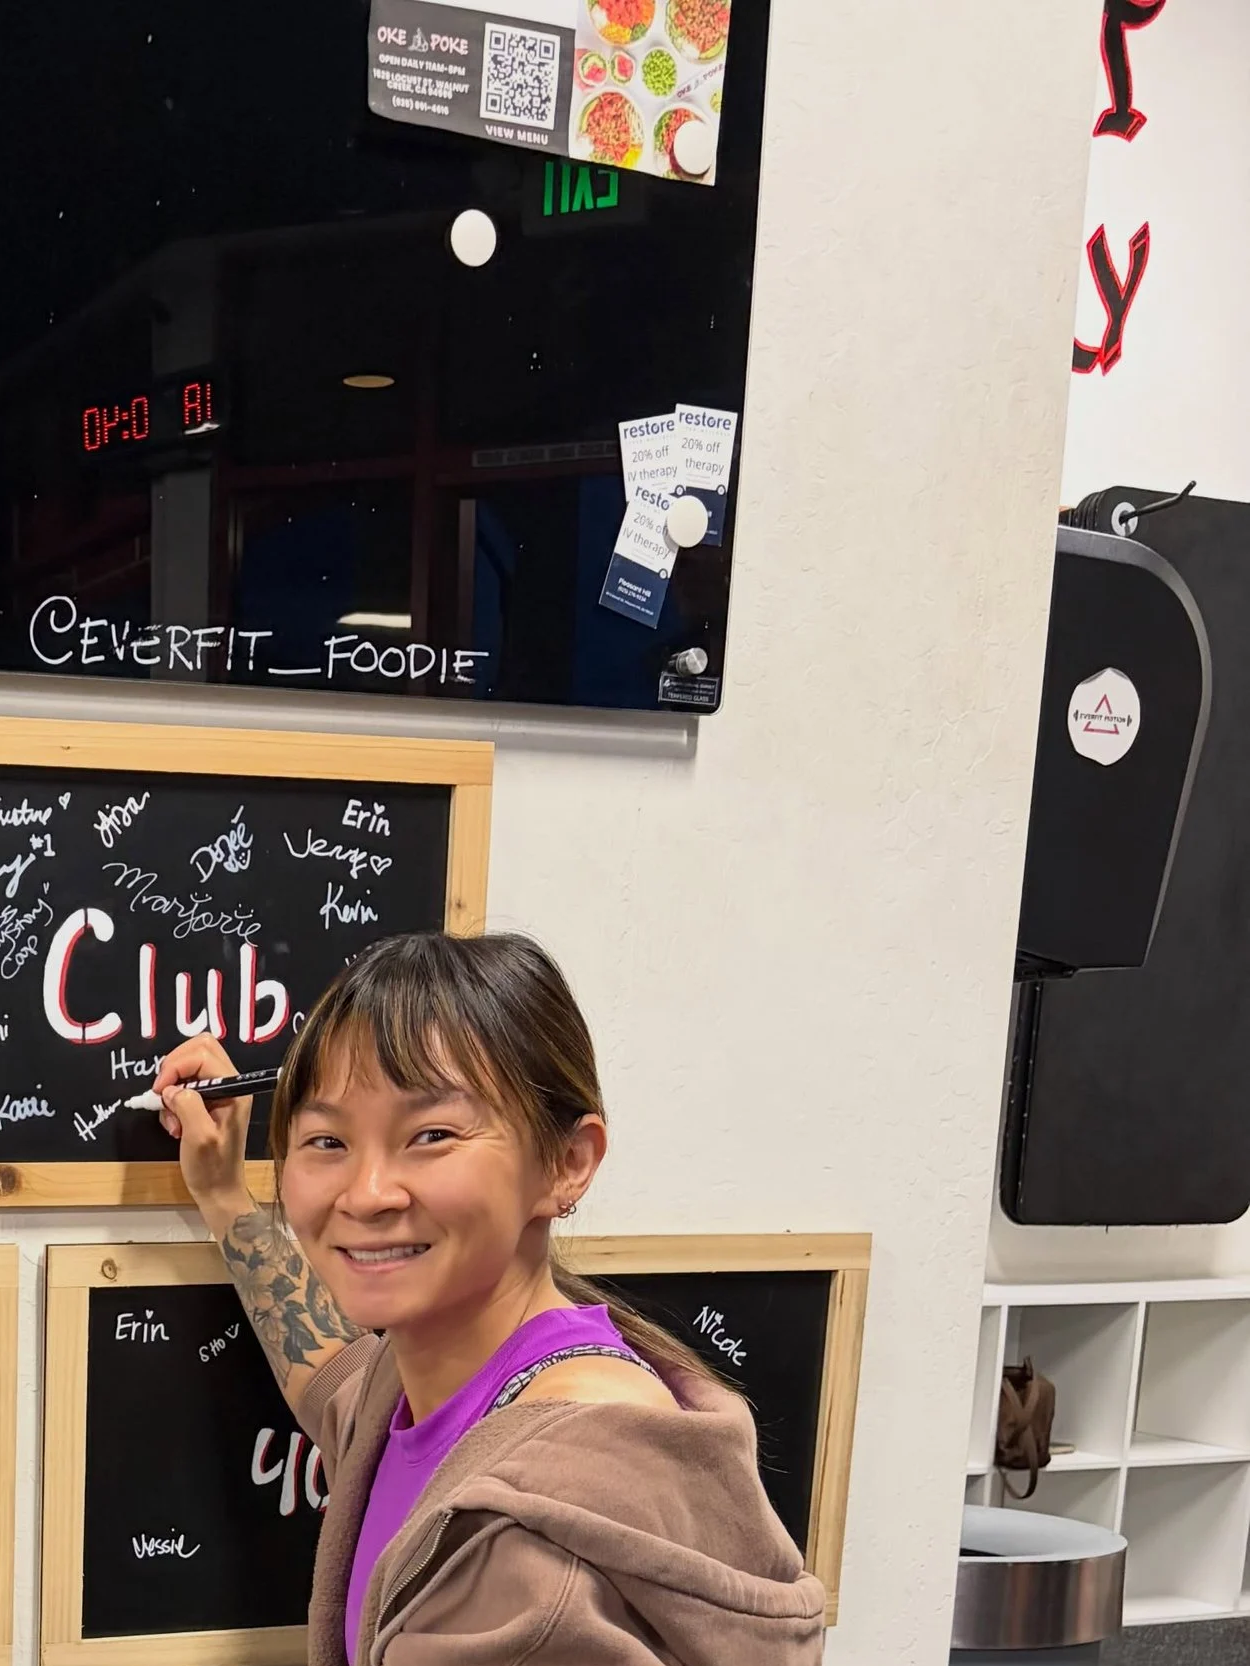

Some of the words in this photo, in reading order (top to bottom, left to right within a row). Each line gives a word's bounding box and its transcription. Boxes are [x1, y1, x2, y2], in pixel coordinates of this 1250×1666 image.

[377, 26, 407, 46] OKE
[430, 33, 469, 55] POKE
[378, 53, 401, 67] OPEN
[484, 124, 514, 140] VIEW
[516, 127, 549, 147] MENU
[623, 418, 675, 440] restore
[678, 410, 732, 431] restore
[632, 448, 654, 464] 20%
[655, 445, 670, 460] off
[681, 437, 704, 452] 20%
[705, 440, 721, 455] off
[626, 470, 638, 483] IV
[639, 465, 678, 482] therapy
[685, 457, 725, 476] therapy
[634, 484, 674, 512] resto
[632, 511, 655, 530] 20%
[622, 526, 634, 540] IV
[634, 532, 672, 560] therapy
[341, 798, 392, 838] Erin
[28, 833, 56, 857] #1
[101, 862, 263, 948] Marjorie
[319, 880, 380, 931] Kevin
[43, 907, 292, 1045] Club
[114, 1309, 171, 1344] Erin
[692, 1305, 748, 1368] Nicole
[251, 1427, 331, 1517] 40
